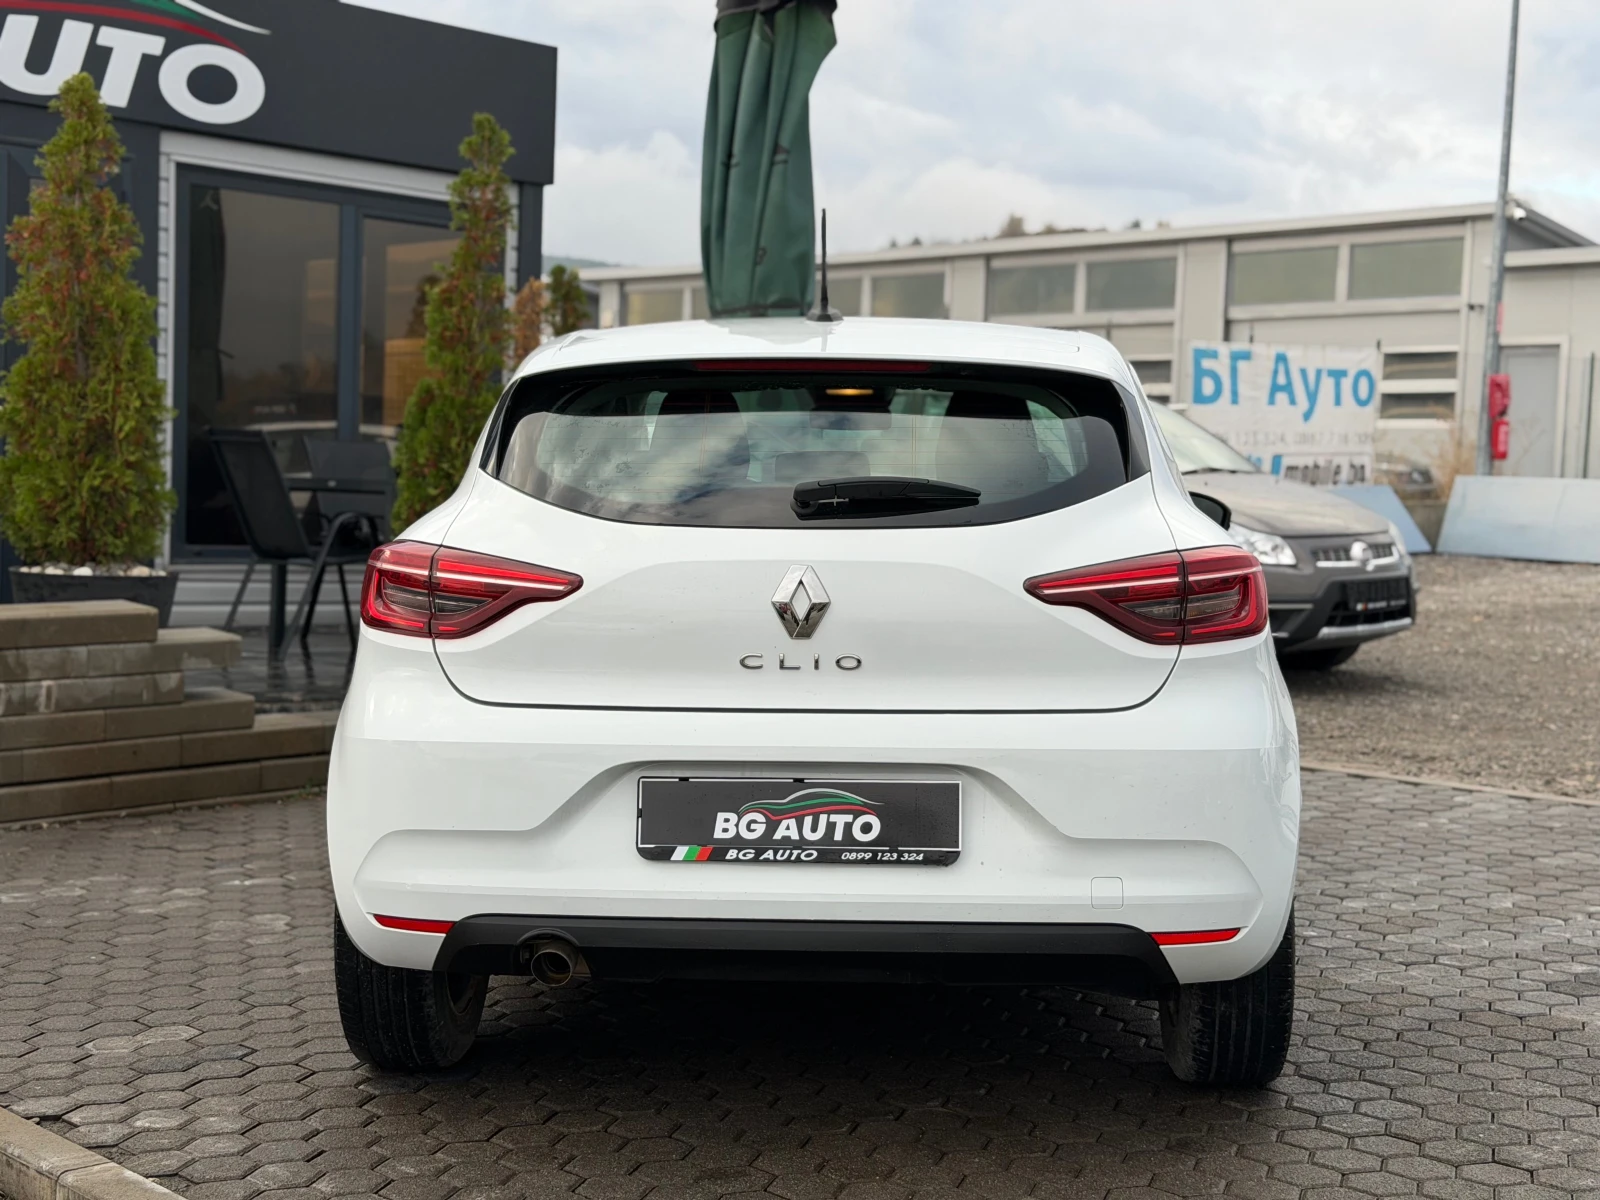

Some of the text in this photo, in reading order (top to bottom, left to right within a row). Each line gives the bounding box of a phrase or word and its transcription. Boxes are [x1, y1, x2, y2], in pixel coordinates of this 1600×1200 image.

[1192, 348, 1376, 423] БГ Ауто
[739, 653, 862, 671] CLIO
[713, 812, 881, 842] BG AUTO
[725, 849, 818, 861] BG AUTO
[841, 851, 924, 861] 0899 123 324
